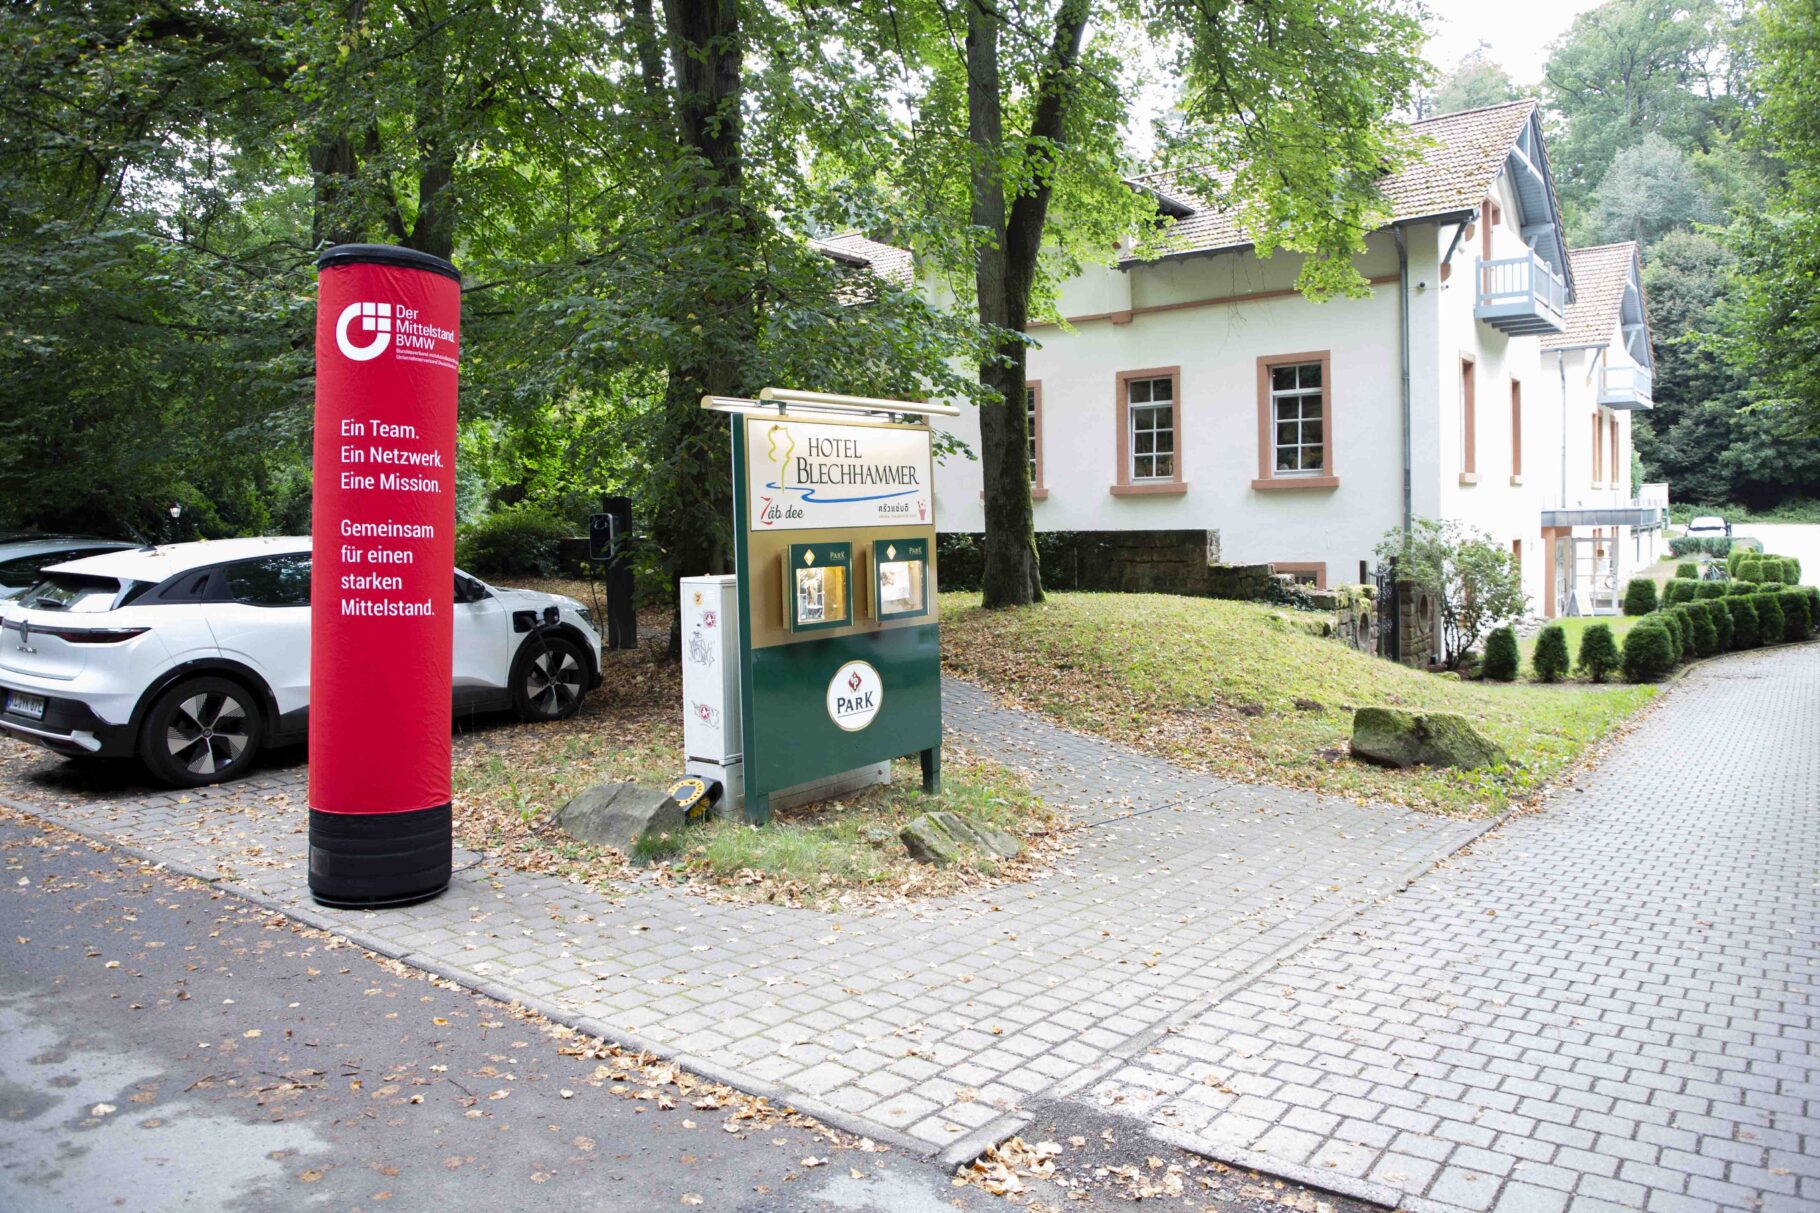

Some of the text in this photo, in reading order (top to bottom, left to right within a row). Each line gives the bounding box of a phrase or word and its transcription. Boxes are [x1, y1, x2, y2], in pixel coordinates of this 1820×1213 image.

[396, 304, 419, 320] Der
[396, 334, 435, 350] BVMW
[341, 419, 419, 439] Ein Team.
[341, 445, 444, 468] Ein Netzwerk.
[808, 437, 862, 459] HOTEL
[796, 456, 920, 485] BLECHHAMMER
[341, 472, 442, 493] Eine Mission.
[785, 504, 804, 519] dee
[341, 519, 434, 538] Gemeinsam
[341, 545, 413, 564] für einen
[829, 551, 846, 560] PARK
[908, 546, 922, 555] PARK
[341, 572, 402, 590] starken
[341, 598, 435, 616] Mittelstand.
[837, 691, 874, 714] PARK
